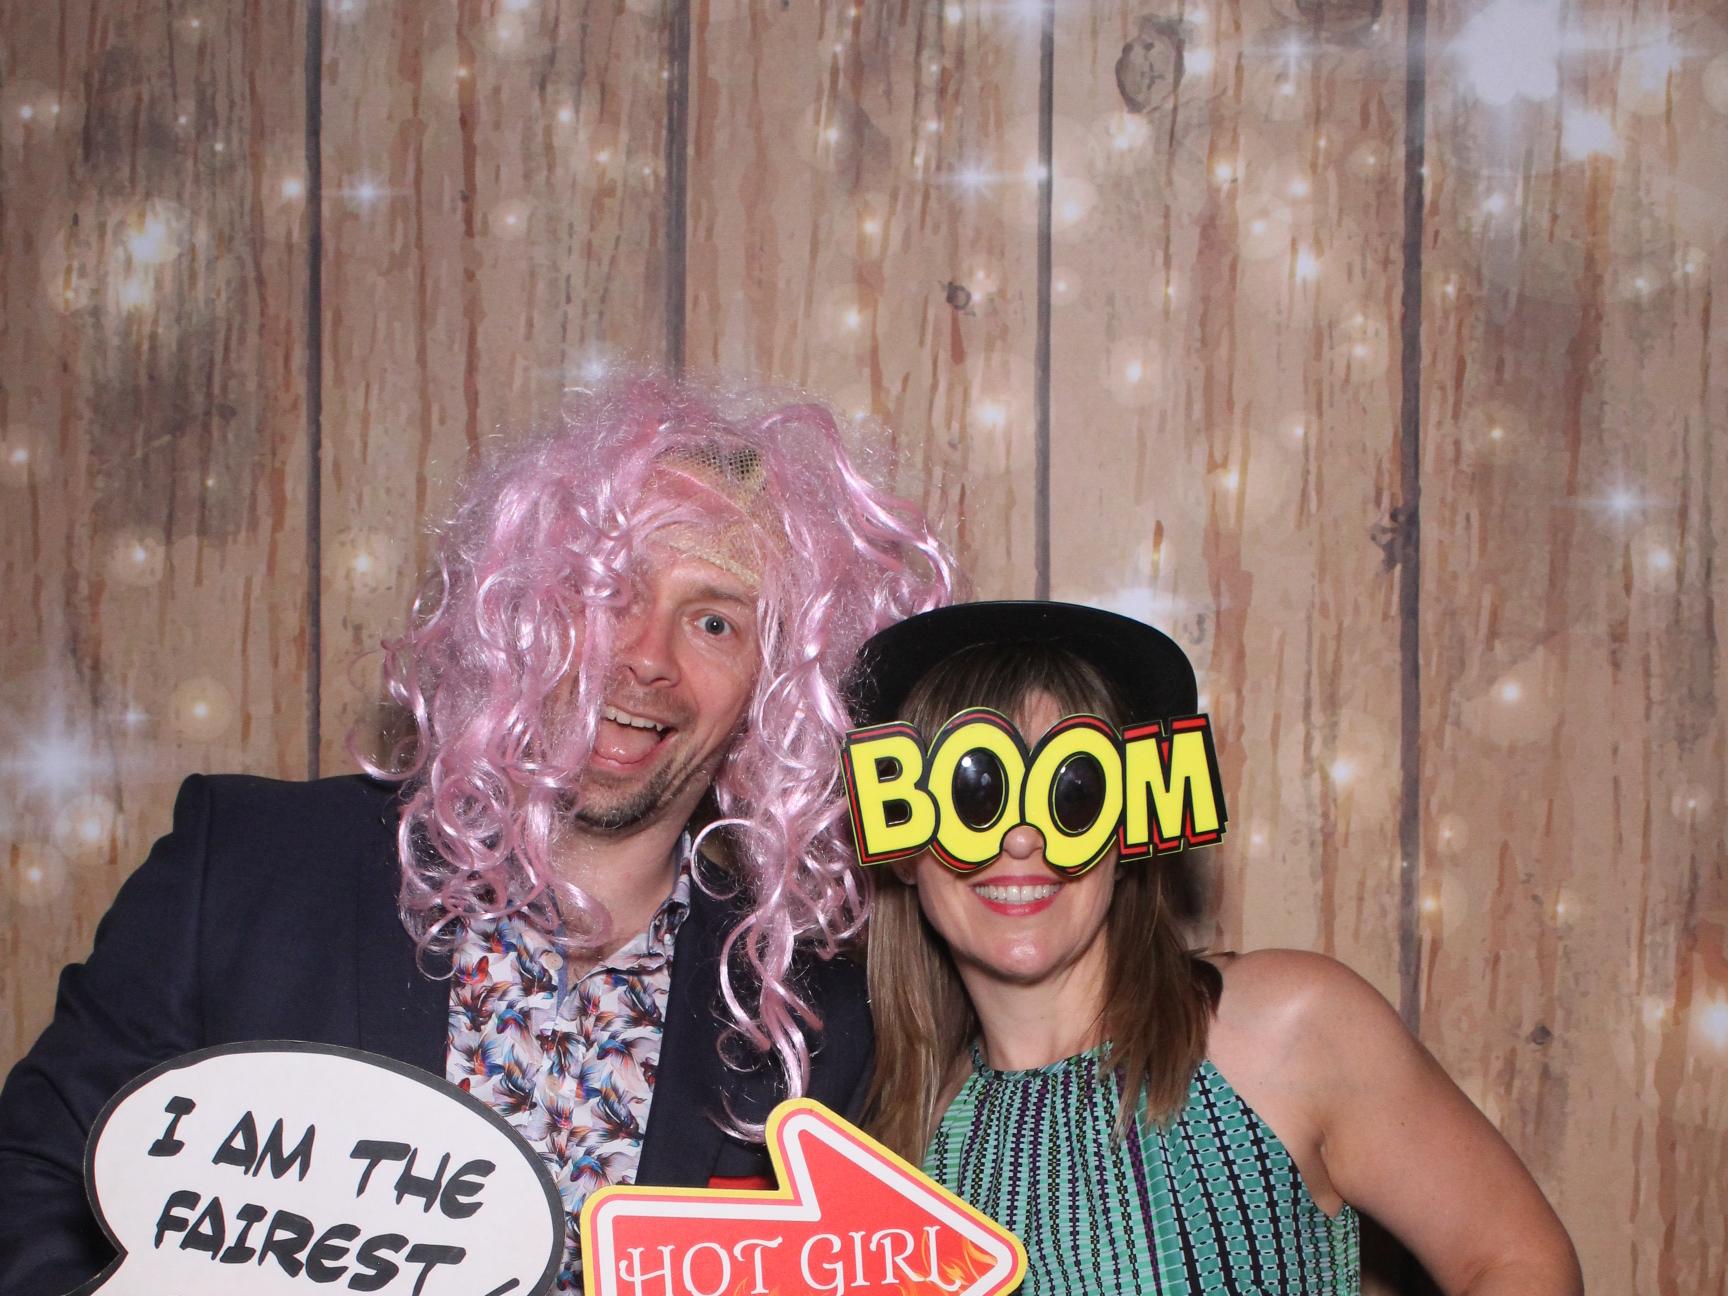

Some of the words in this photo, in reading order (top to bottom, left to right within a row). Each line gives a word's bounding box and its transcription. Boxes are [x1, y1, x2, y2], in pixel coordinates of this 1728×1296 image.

[847, 716, 1222, 871] BOOM
[147, 1095, 196, 1157] I
[211, 1110, 316, 1182] AM
[349, 1139, 497, 1220] THE
